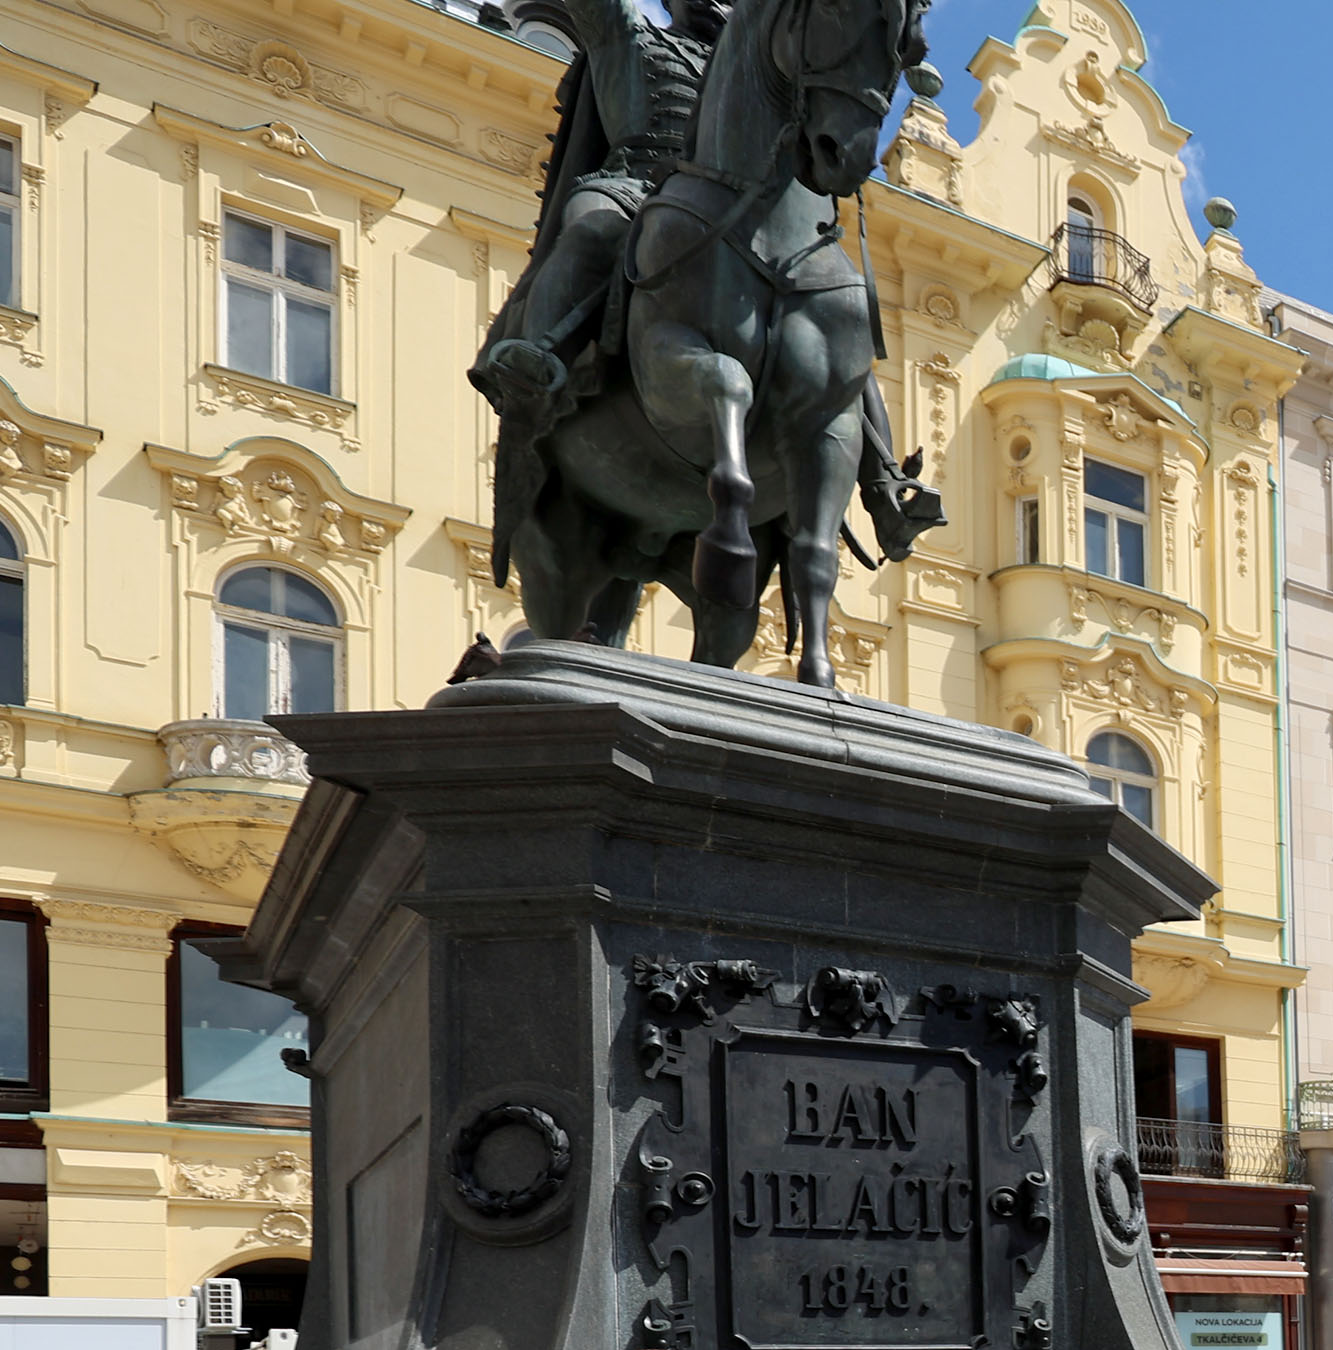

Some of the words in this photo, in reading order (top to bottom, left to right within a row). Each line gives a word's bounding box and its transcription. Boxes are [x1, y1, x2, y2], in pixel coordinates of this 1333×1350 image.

[782, 1079, 918, 1150] BAN
[733, 1162, 973, 1241] JELAČIĆ
[798, 1264, 932, 1319] 1848.
[1195, 1318, 1220, 1326] NOVA
[1222, 1318, 1264, 1326] LOKACIJA
